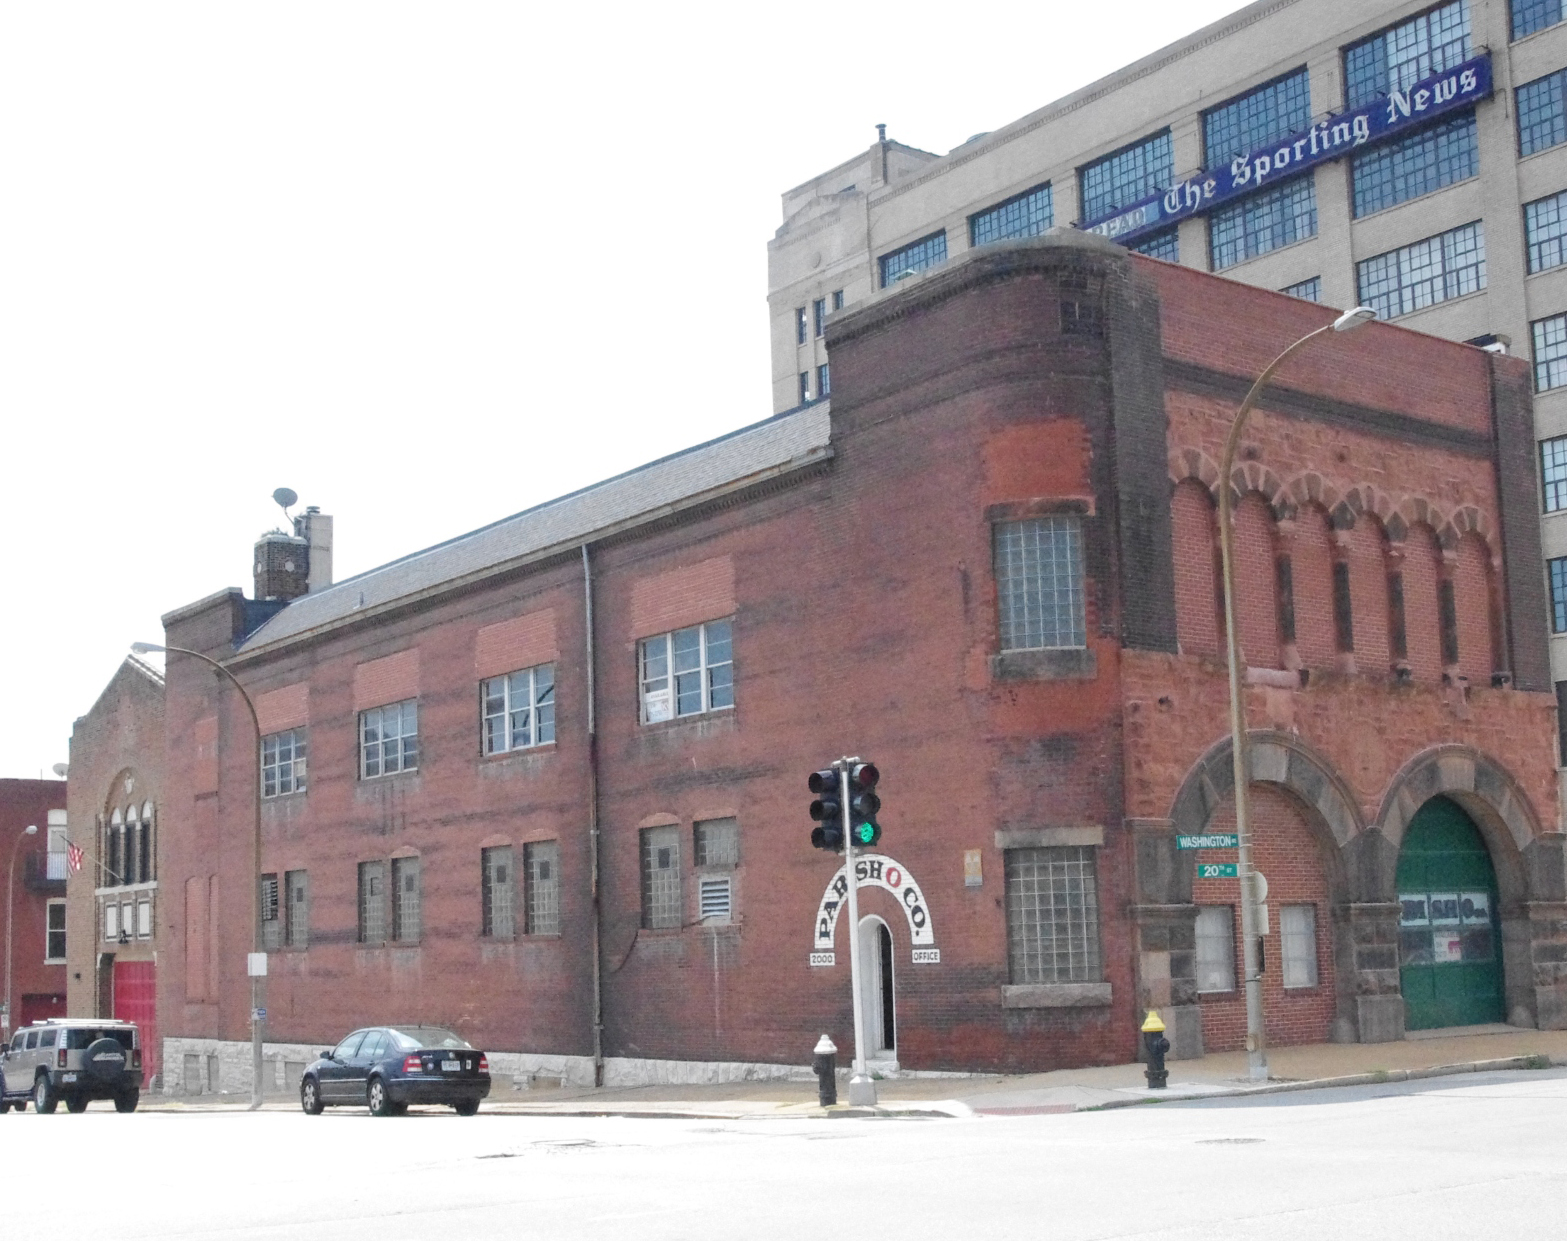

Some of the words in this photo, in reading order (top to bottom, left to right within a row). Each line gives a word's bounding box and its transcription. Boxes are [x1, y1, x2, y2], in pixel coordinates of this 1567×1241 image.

[1164, 179, 1217, 214] The
[1231, 115, 1369, 189] Sporting
[1387, 67, 1477, 124] News
[1180, 836, 1231, 847] WASHINGTON
[812, 955, 833, 964] 2000
[914, 952, 938, 962] OFFICE
